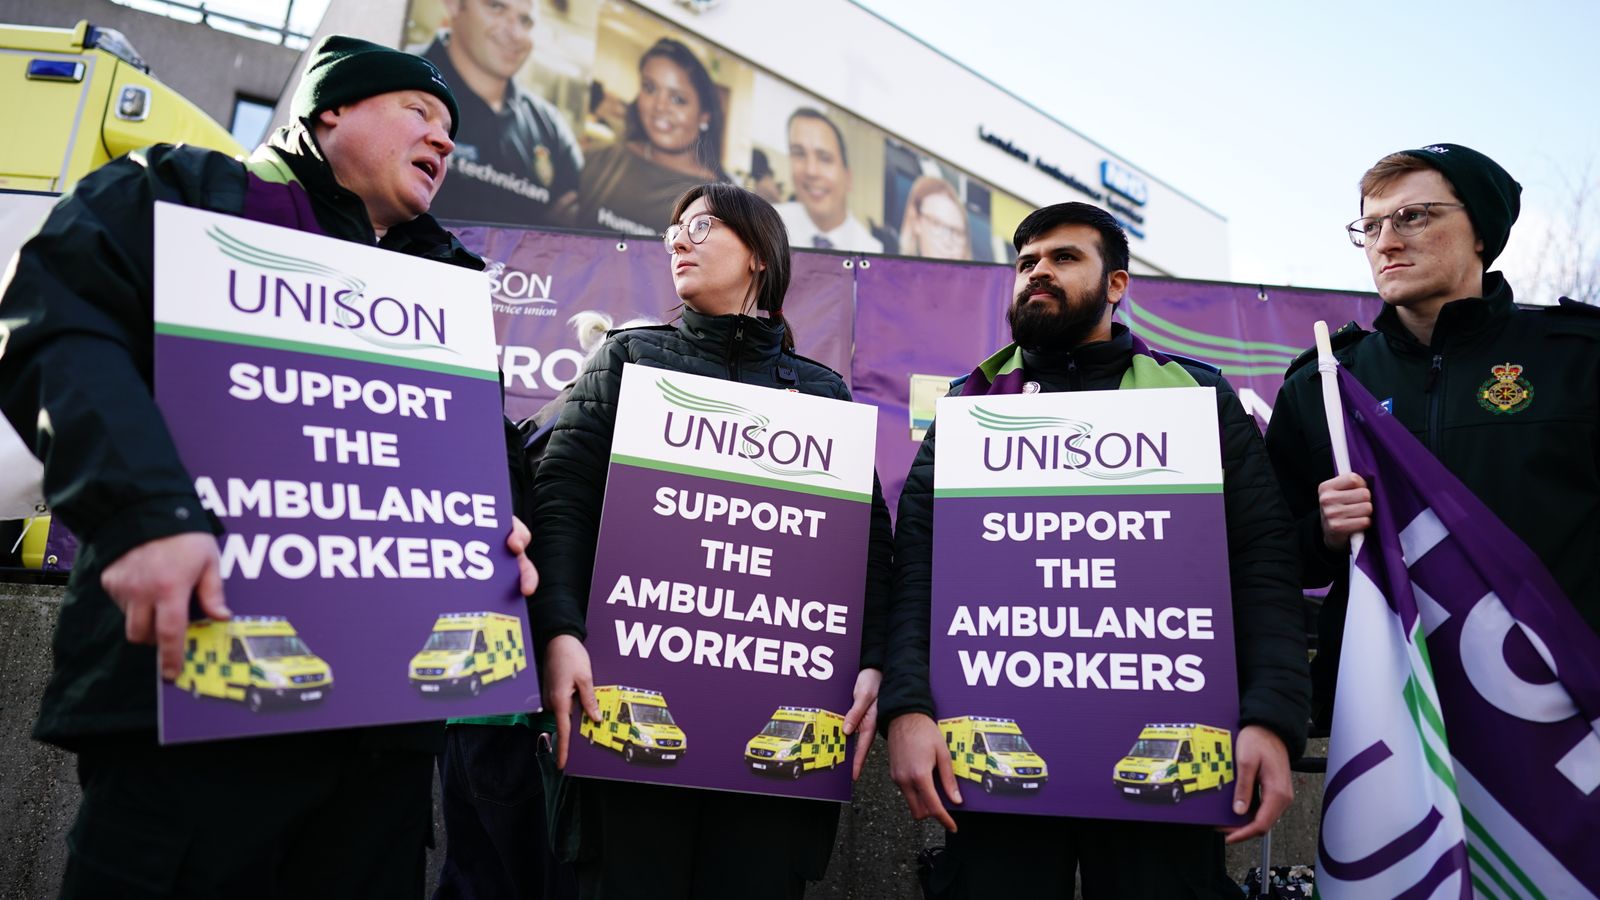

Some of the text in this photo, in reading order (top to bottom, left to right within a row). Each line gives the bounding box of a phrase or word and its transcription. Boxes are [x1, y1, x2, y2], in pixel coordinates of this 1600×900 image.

[458, 158, 550, 203] technician
[487, 268, 553, 299] SON
[229, 269, 446, 345] UNISON
[523, 304, 558, 317] union
[228, 362, 452, 421] SUPPORT
[303, 425, 400, 468] THE
[663, 411, 834, 472] UNISON
[983, 431, 1168, 472] UNISON
[193, 475, 498, 528] AMBULANCE
[653, 486, 826, 538] SUPPORT
[981, 510, 1171, 542] SUPPORT
[220, 533, 494, 581] WORKERS
[700, 538, 773, 577] THE
[1036, 558, 1117, 589] THE
[606, 574, 849, 635] AMBULANCE
[947, 605, 1215, 640] AMBULANCE
[614, 619, 835, 681] WORKERS
[957, 650, 1206, 693] WORKERS
